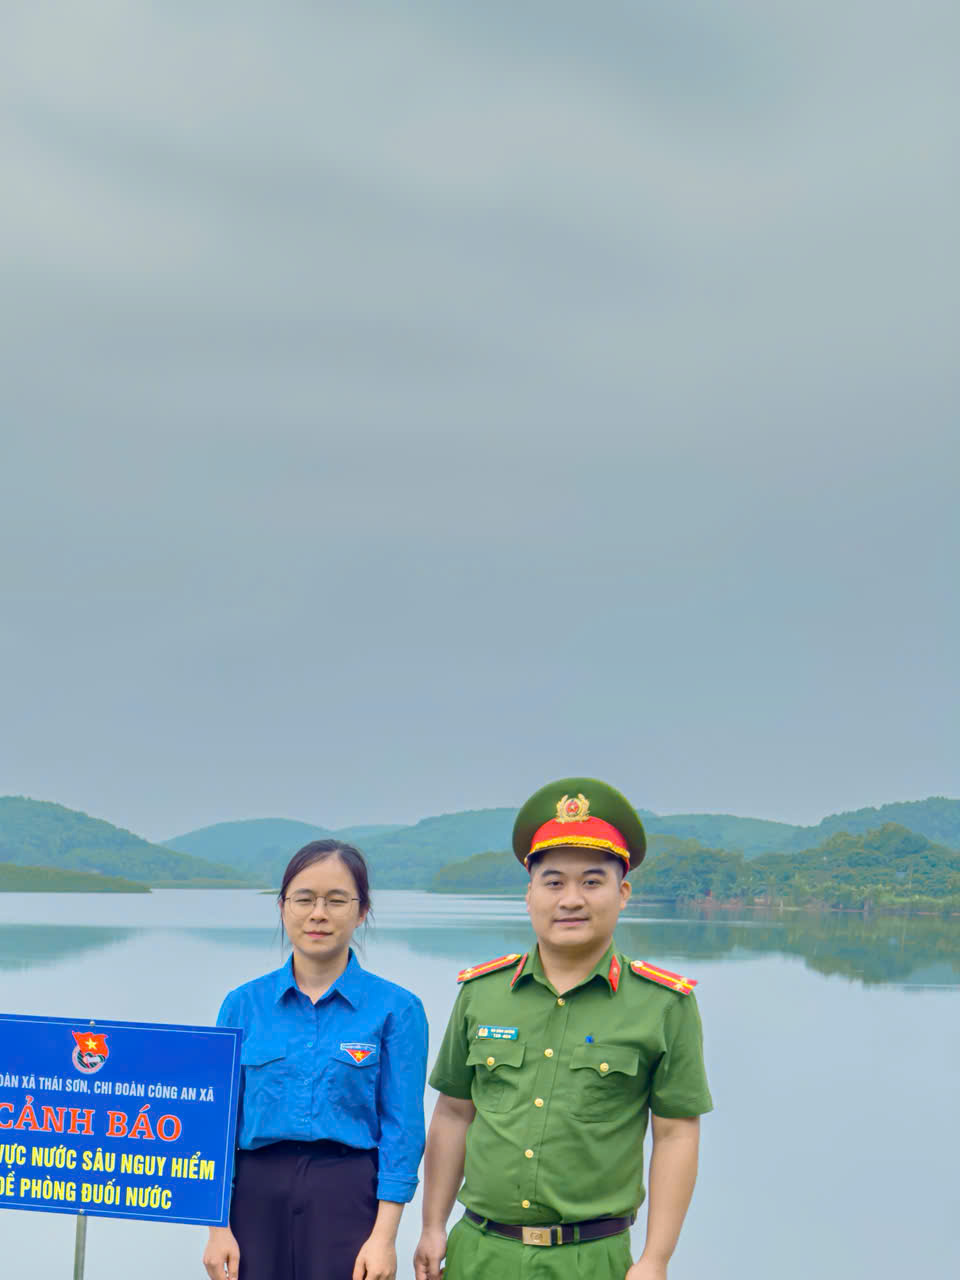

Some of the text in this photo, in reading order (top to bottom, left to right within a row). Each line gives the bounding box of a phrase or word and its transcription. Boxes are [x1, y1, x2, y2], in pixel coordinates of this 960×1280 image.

[21, 1074, 36, 1090] XÃ
[38, 1075, 63, 1092] THÁI
[65, 1078, 91, 1094] SƠN,
[93, 1080, 113, 1095] CHI
[114, 1080, 145, 1098] ĐOÀN
[147, 1083, 178, 1100] CÔNG
[180, 1087, 197, 1101] AN
[199, 1087, 214, 1103] XÃ
[105, 1103, 183, 1142] BÁO
[31, 1144, 77, 1170] NƯỚC
[81, 1147, 116, 1173] SÂU
[120, 1153, 167, 1177] NGUY
[170, 1151, 216, 1181] HIỂM
[19, 1175, 77, 1202] PHÒNG
[80, 1178, 121, 1206] ĐUỐI
[125, 1184, 173, 1210] NƯỚC
